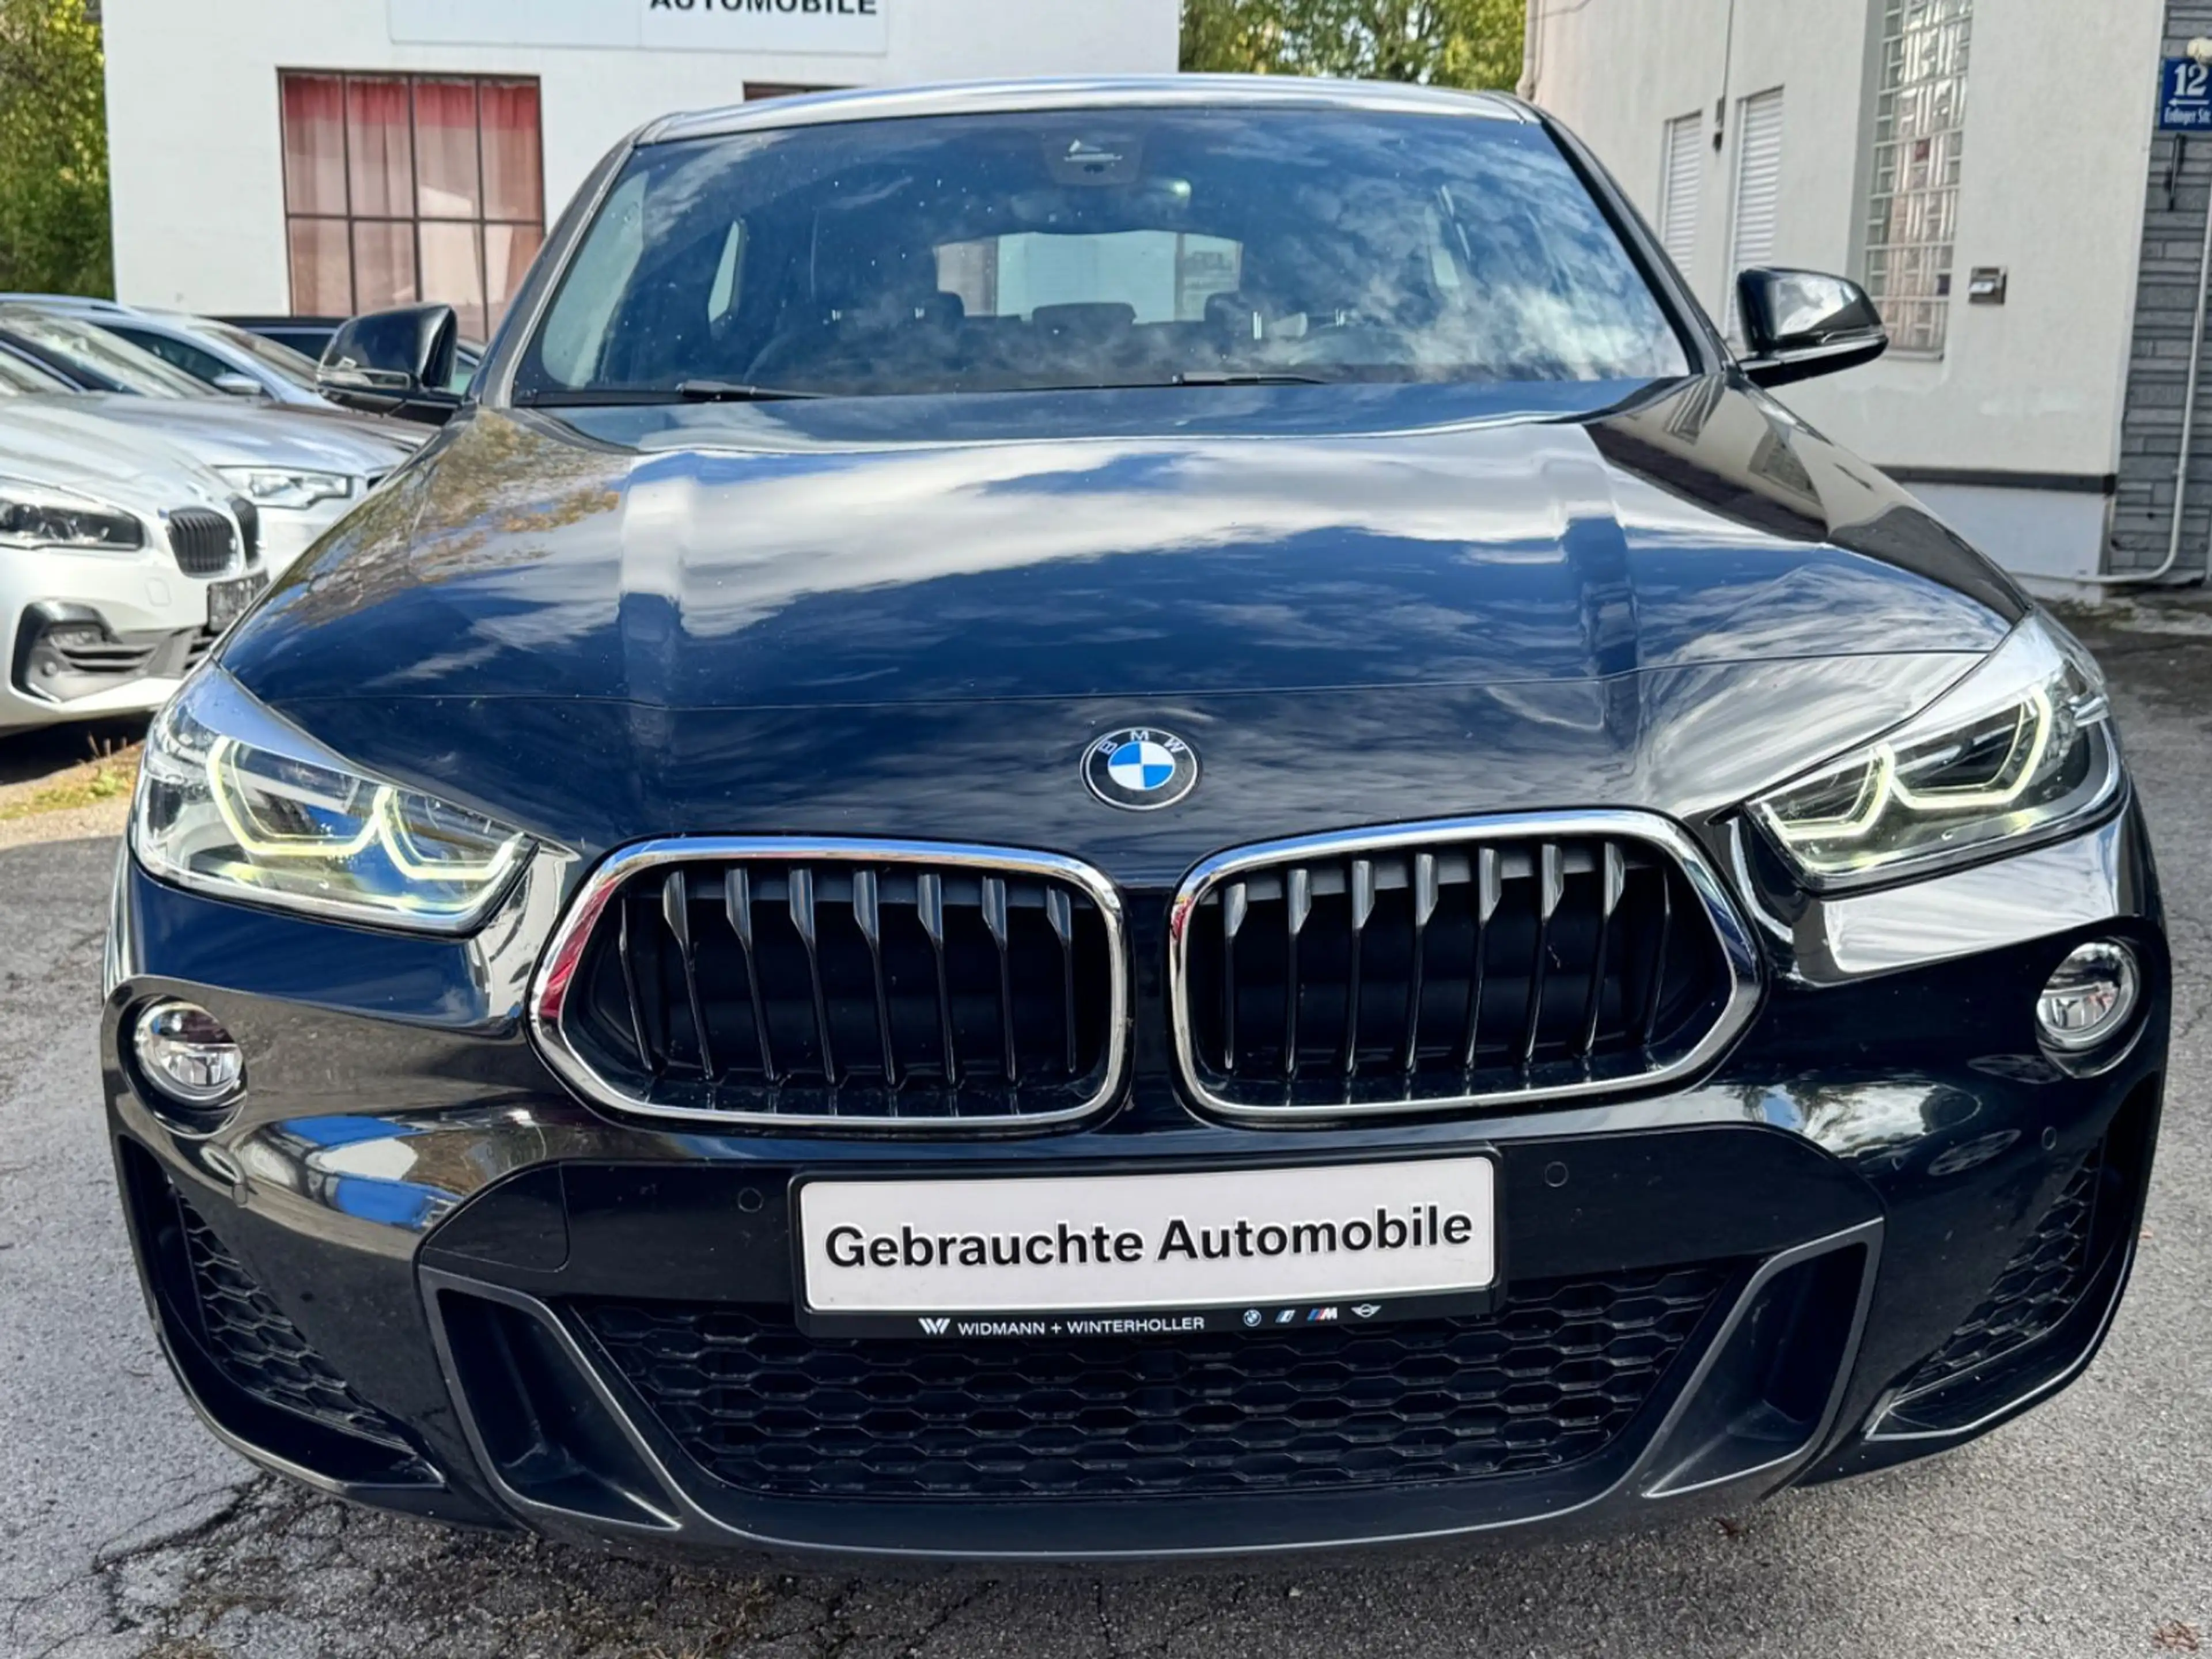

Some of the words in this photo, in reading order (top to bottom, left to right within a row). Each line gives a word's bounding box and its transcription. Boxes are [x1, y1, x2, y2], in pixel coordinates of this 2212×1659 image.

[2173, 63, 2209, 96] 12
[1097, 729, 1184, 756] BMW
[825, 1222, 1143, 1267] Gebrauchte
[1157, 1205, 1472, 1260] Automobile
[957, 1322, 1045, 1335] WIDMANN
[1051, 1323, 1062, 1334] +
[1067, 1317, 1205, 1334] WINTERHOLLER
